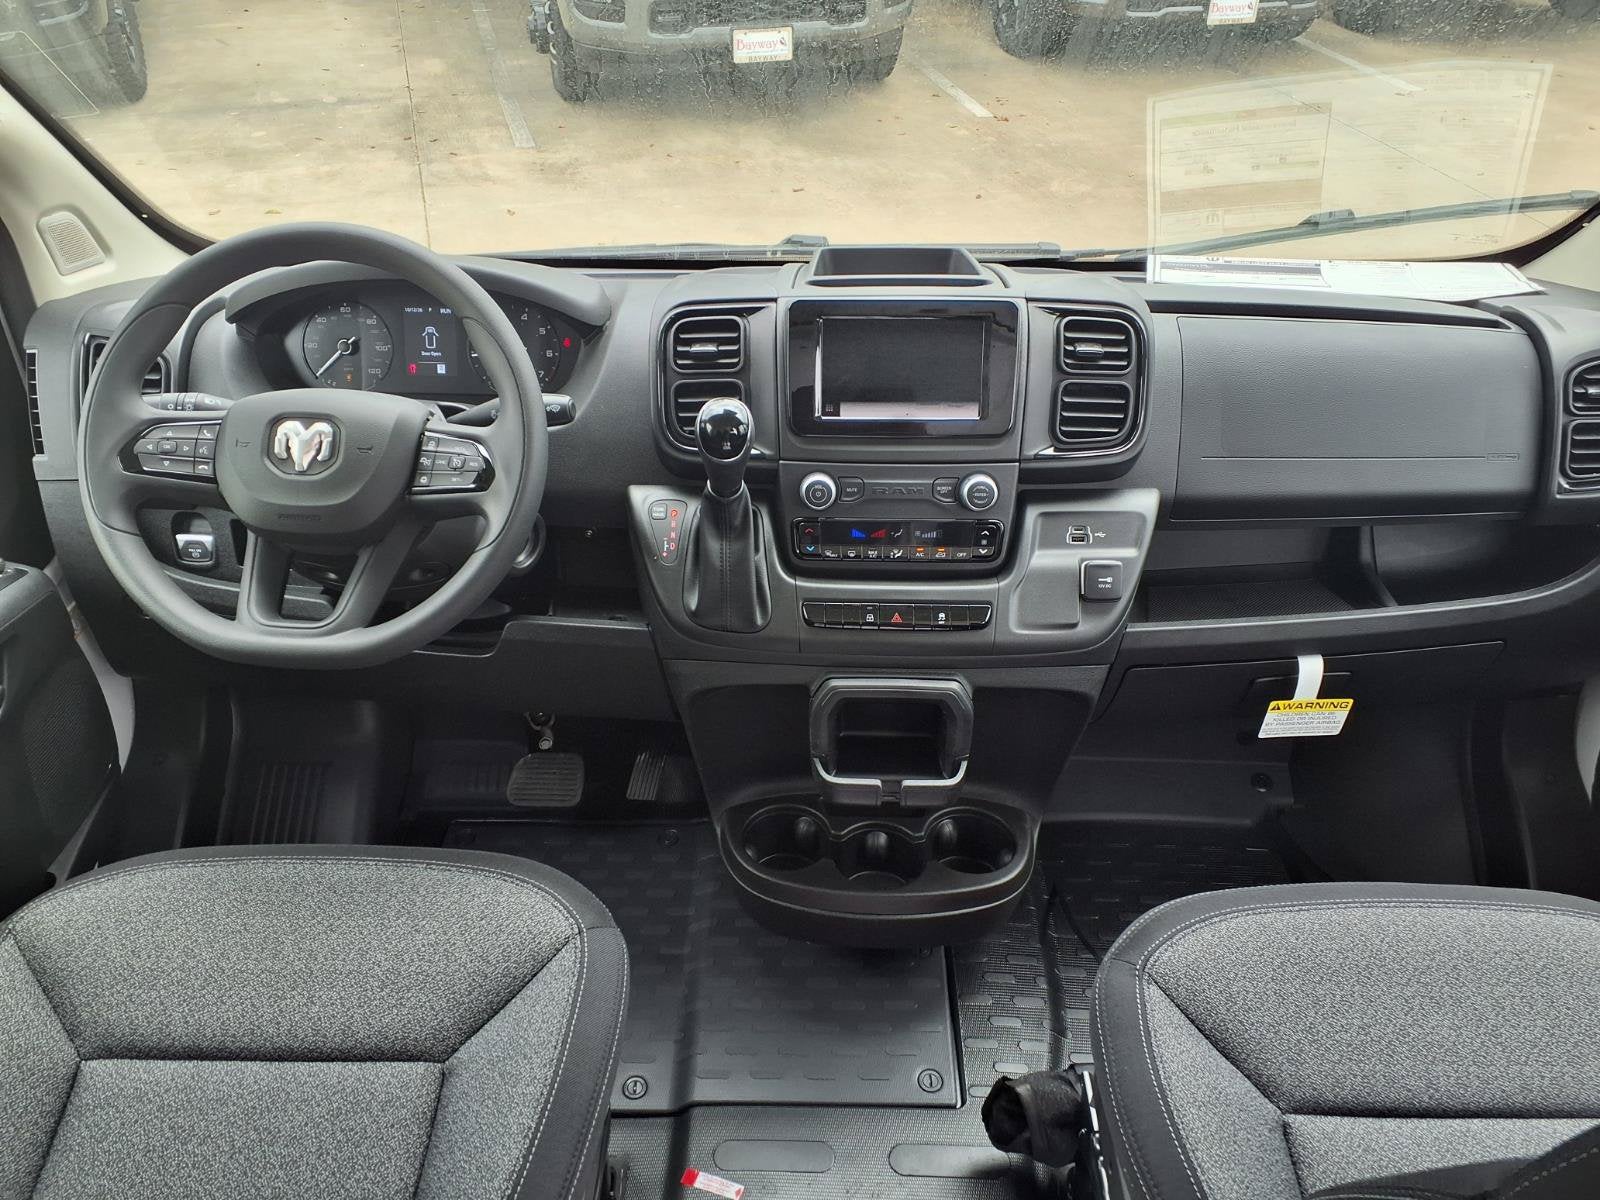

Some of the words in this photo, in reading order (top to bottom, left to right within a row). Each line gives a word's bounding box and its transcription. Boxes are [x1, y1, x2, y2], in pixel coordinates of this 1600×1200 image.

[736, 38, 780, 50] Bayway
[539, 327, 546, 335] 5
[538, 370, 545, 378] 7
[872, 486, 925, 497] RAM
[670, 542, 676, 550] D
[1282, 702, 1349, 710] WARNING
